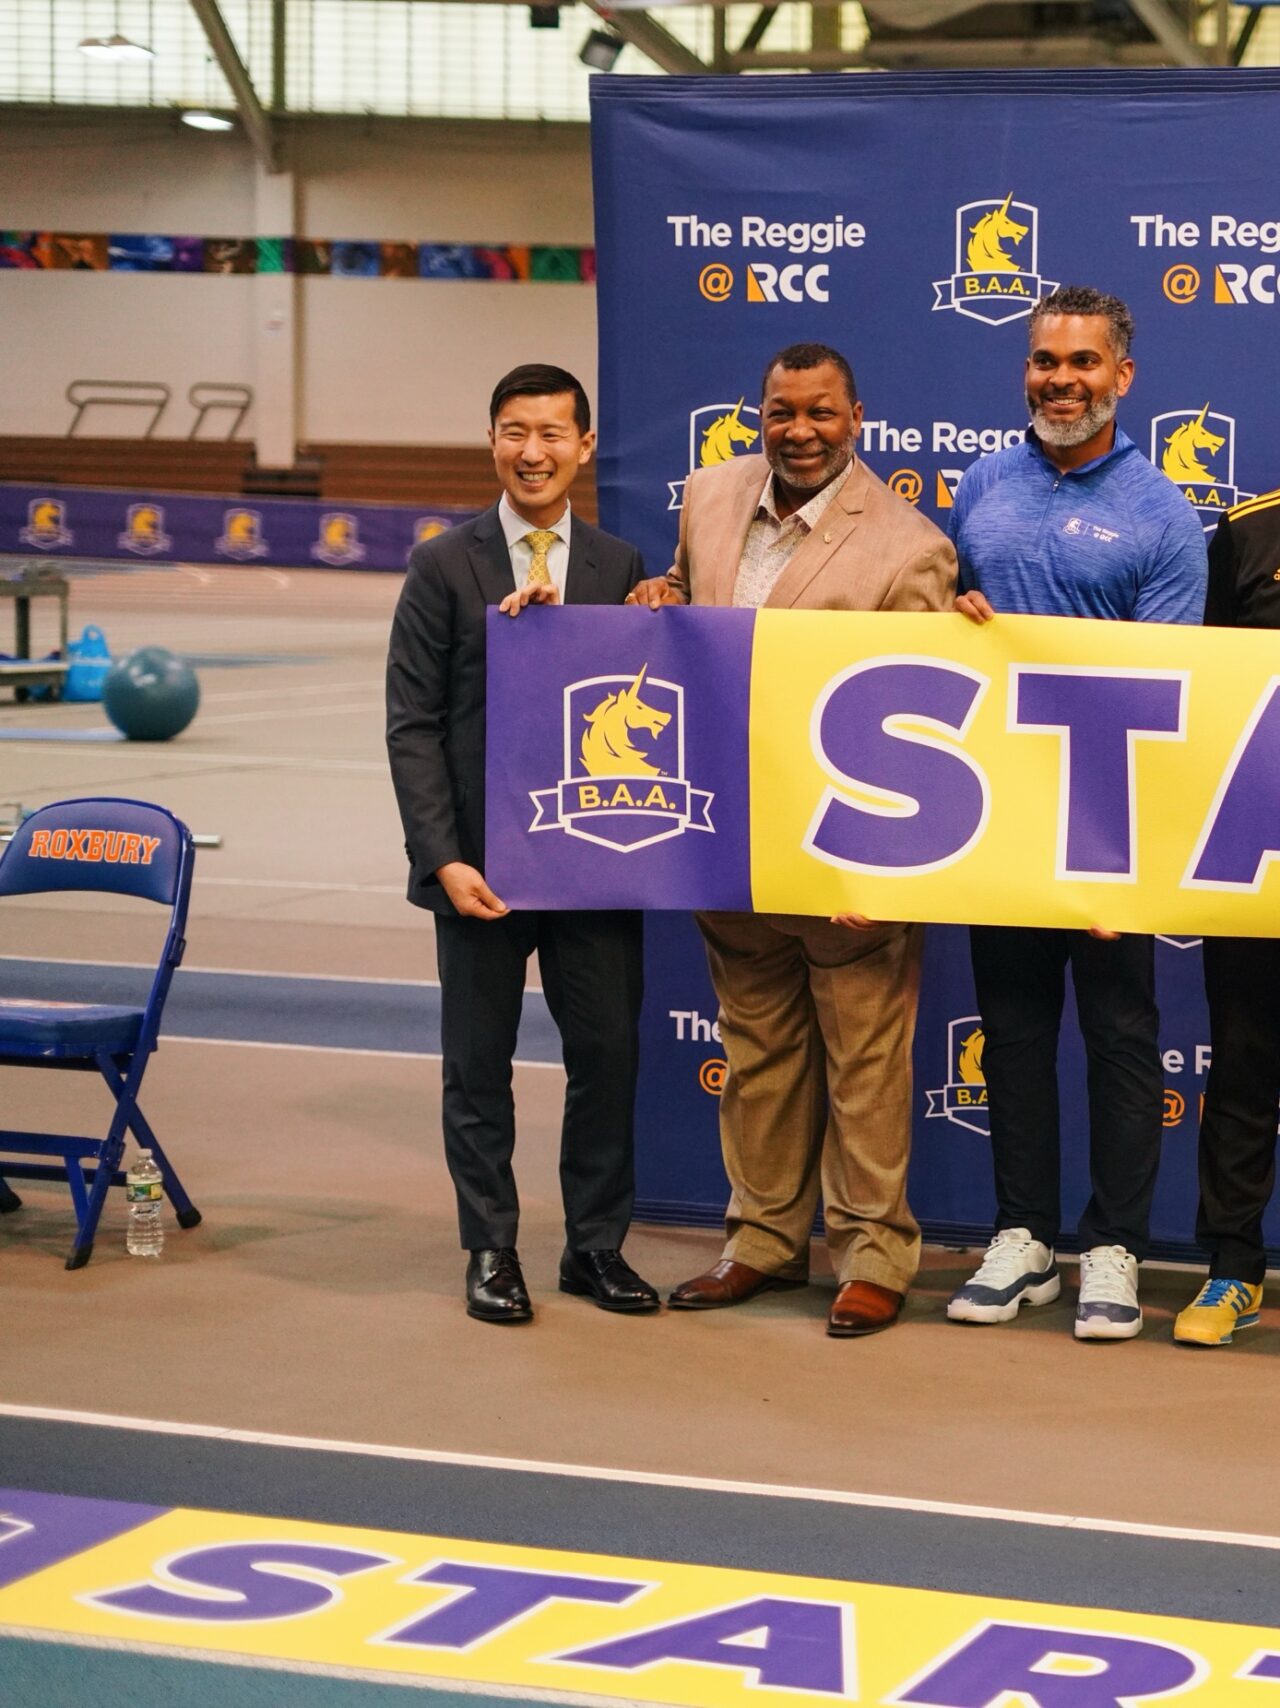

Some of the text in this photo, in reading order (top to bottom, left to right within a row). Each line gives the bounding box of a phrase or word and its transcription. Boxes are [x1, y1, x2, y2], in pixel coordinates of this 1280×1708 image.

[667, 215, 866, 254] The Reggie
[1130, 214, 1200, 247] The
[699, 263, 829, 302] @ RCC
[964, 276, 1031, 295] B.A.A.
[1162, 264, 1200, 304] @
[860, 420, 922, 453] The
[578, 783, 676, 810] B.A.A.
[28, 829, 161, 865] ROXBURY
